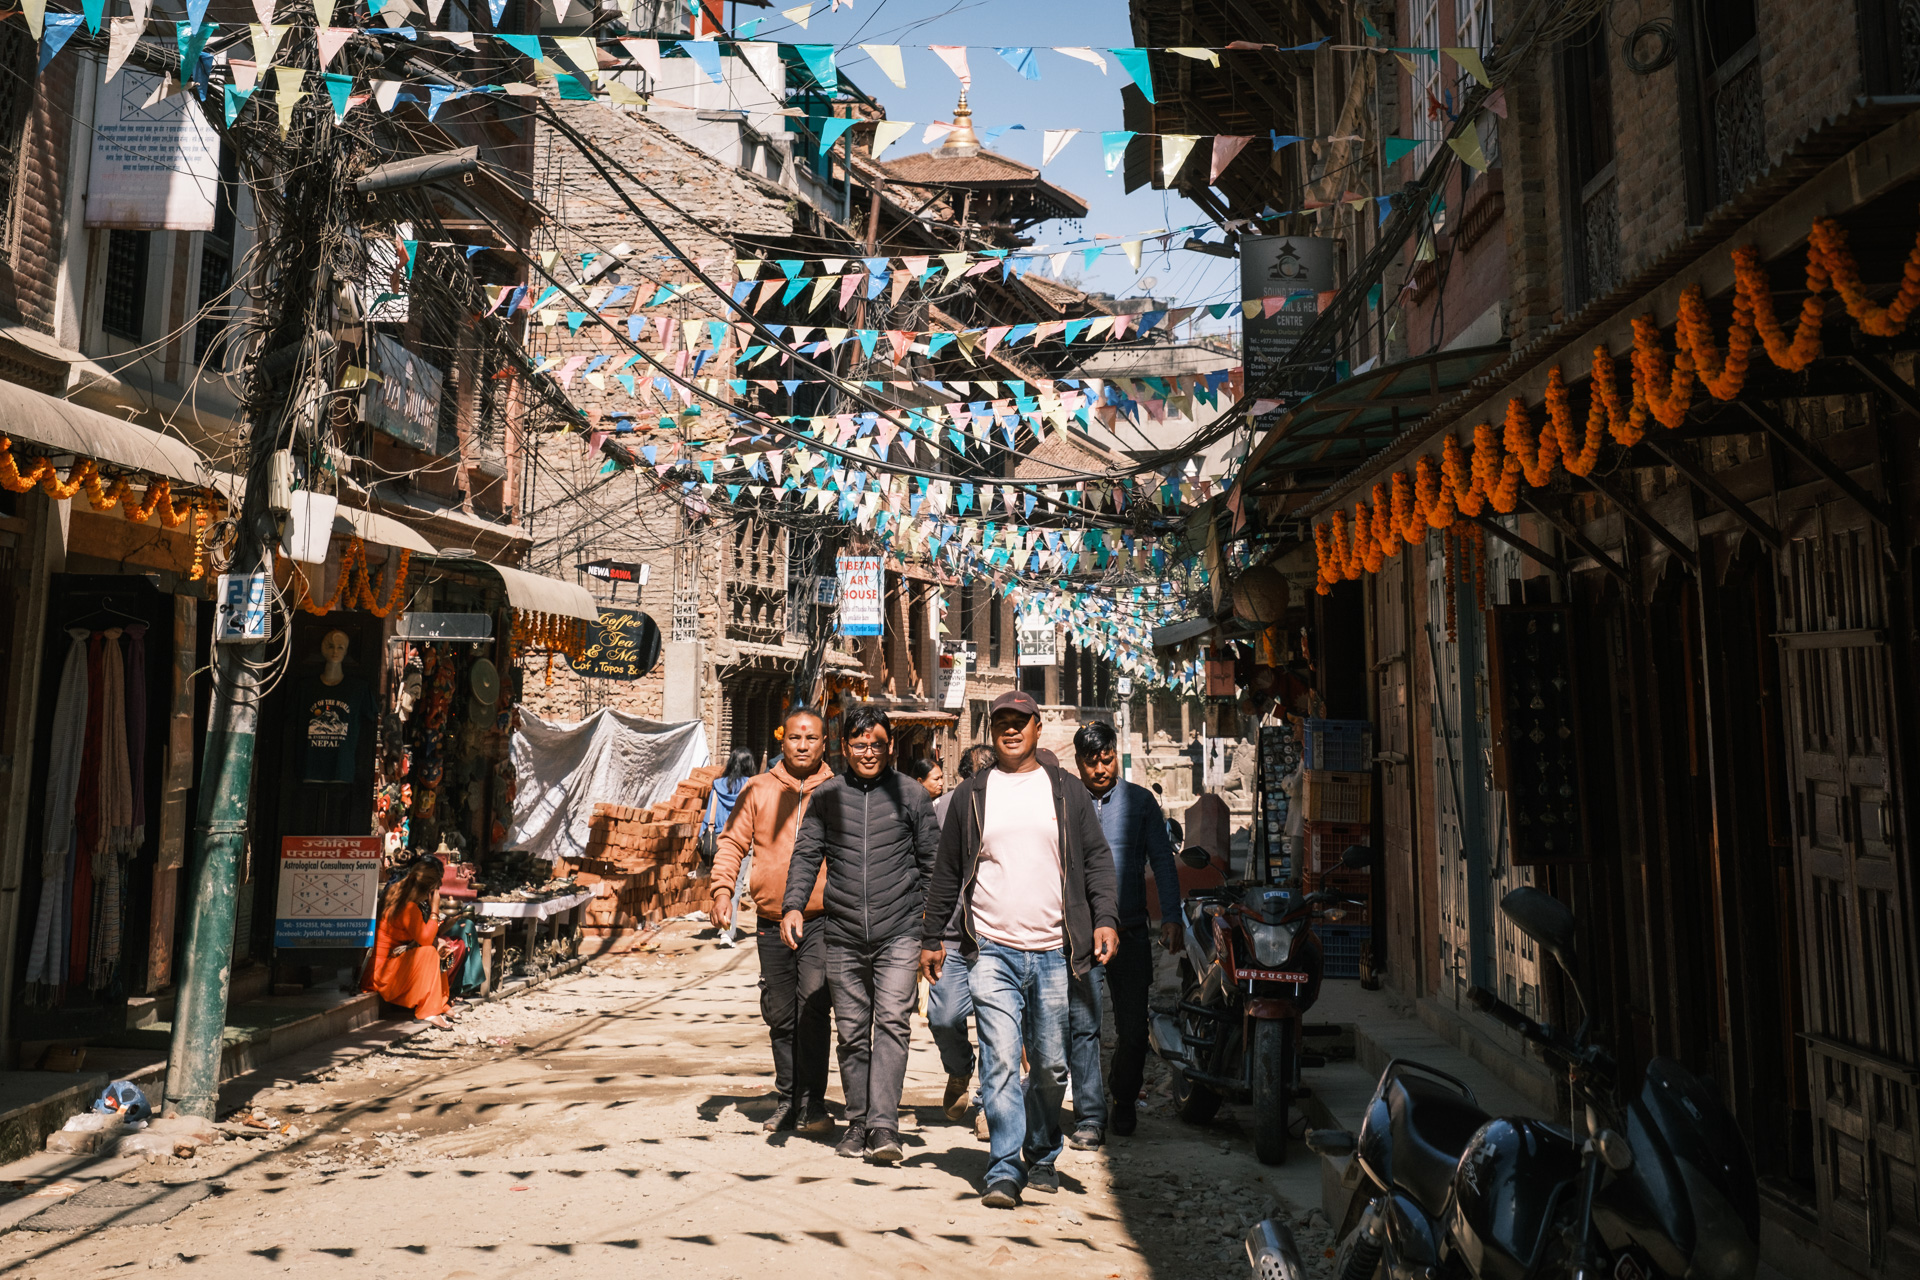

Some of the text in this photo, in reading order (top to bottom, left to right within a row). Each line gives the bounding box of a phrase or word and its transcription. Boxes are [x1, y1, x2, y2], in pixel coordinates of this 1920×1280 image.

[1276, 315, 1304, 327] CENTRE
[838, 561, 881, 571] TIBETAN
[587, 565, 632, 581] NEWA SAWA
[850, 576, 869, 585] ART
[843, 589, 877, 600] HOUSE
[589, 612, 643, 631] Coffee
[598, 629, 637, 648] Tea
[583, 644, 640, 662] & Me
[302, 838, 362, 848] ज्योतिष
[286, 848, 377, 858] परामर्श सेवा
[284, 860, 377, 872] Astrological Consultancy Service
[303, 930, 325, 938] Jyotish
